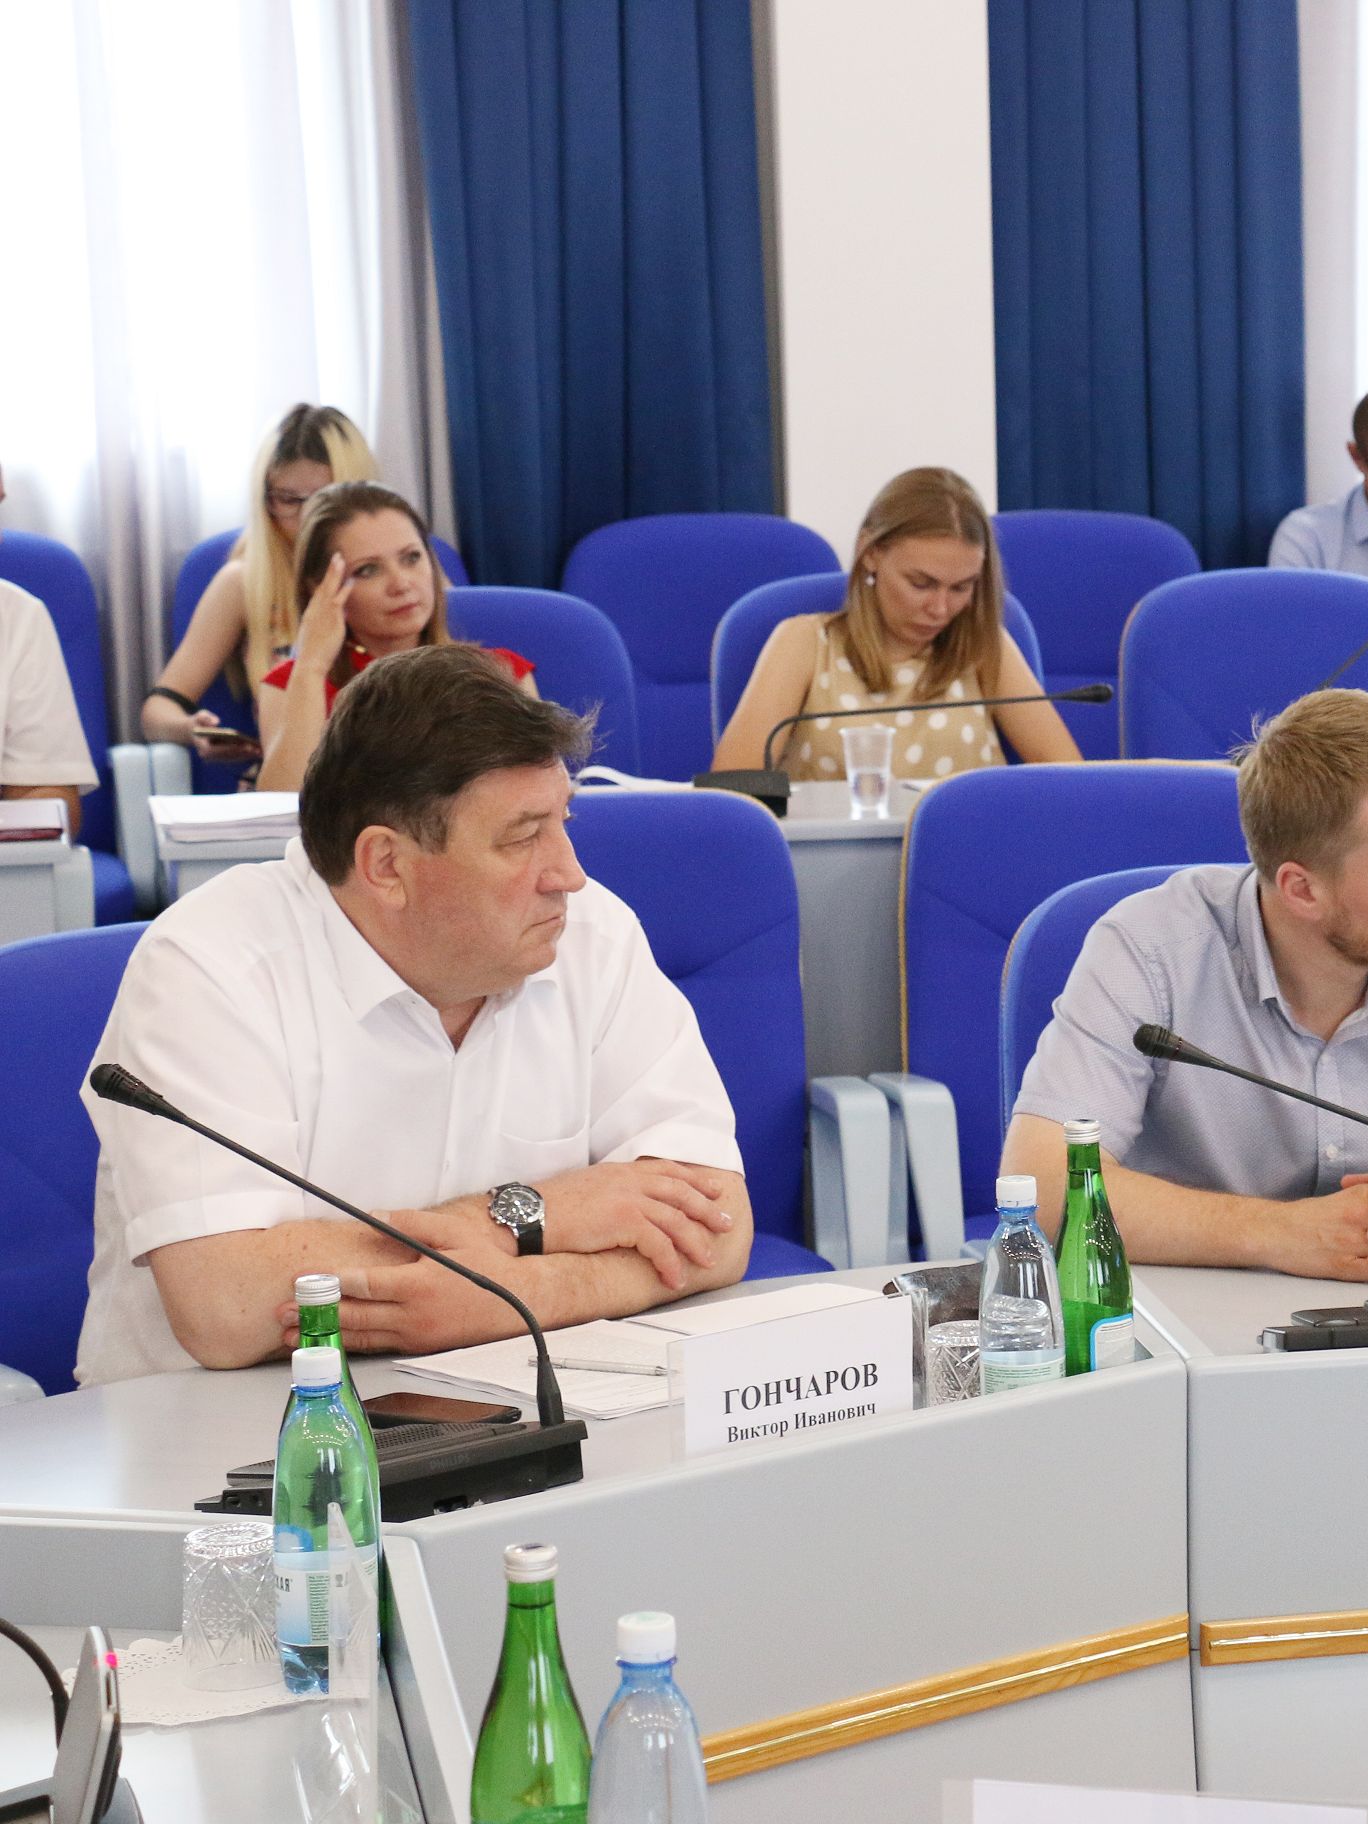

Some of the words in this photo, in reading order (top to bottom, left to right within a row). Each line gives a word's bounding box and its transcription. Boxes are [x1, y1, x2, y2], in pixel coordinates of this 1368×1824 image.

[723, 1362, 879, 1415] ГОНЧАРОВ
[727, 1420, 789, 1444] Виктор
[794, 1402, 877, 1430] Иванович
[428, 1453, 471, 1471] PHILIPS
